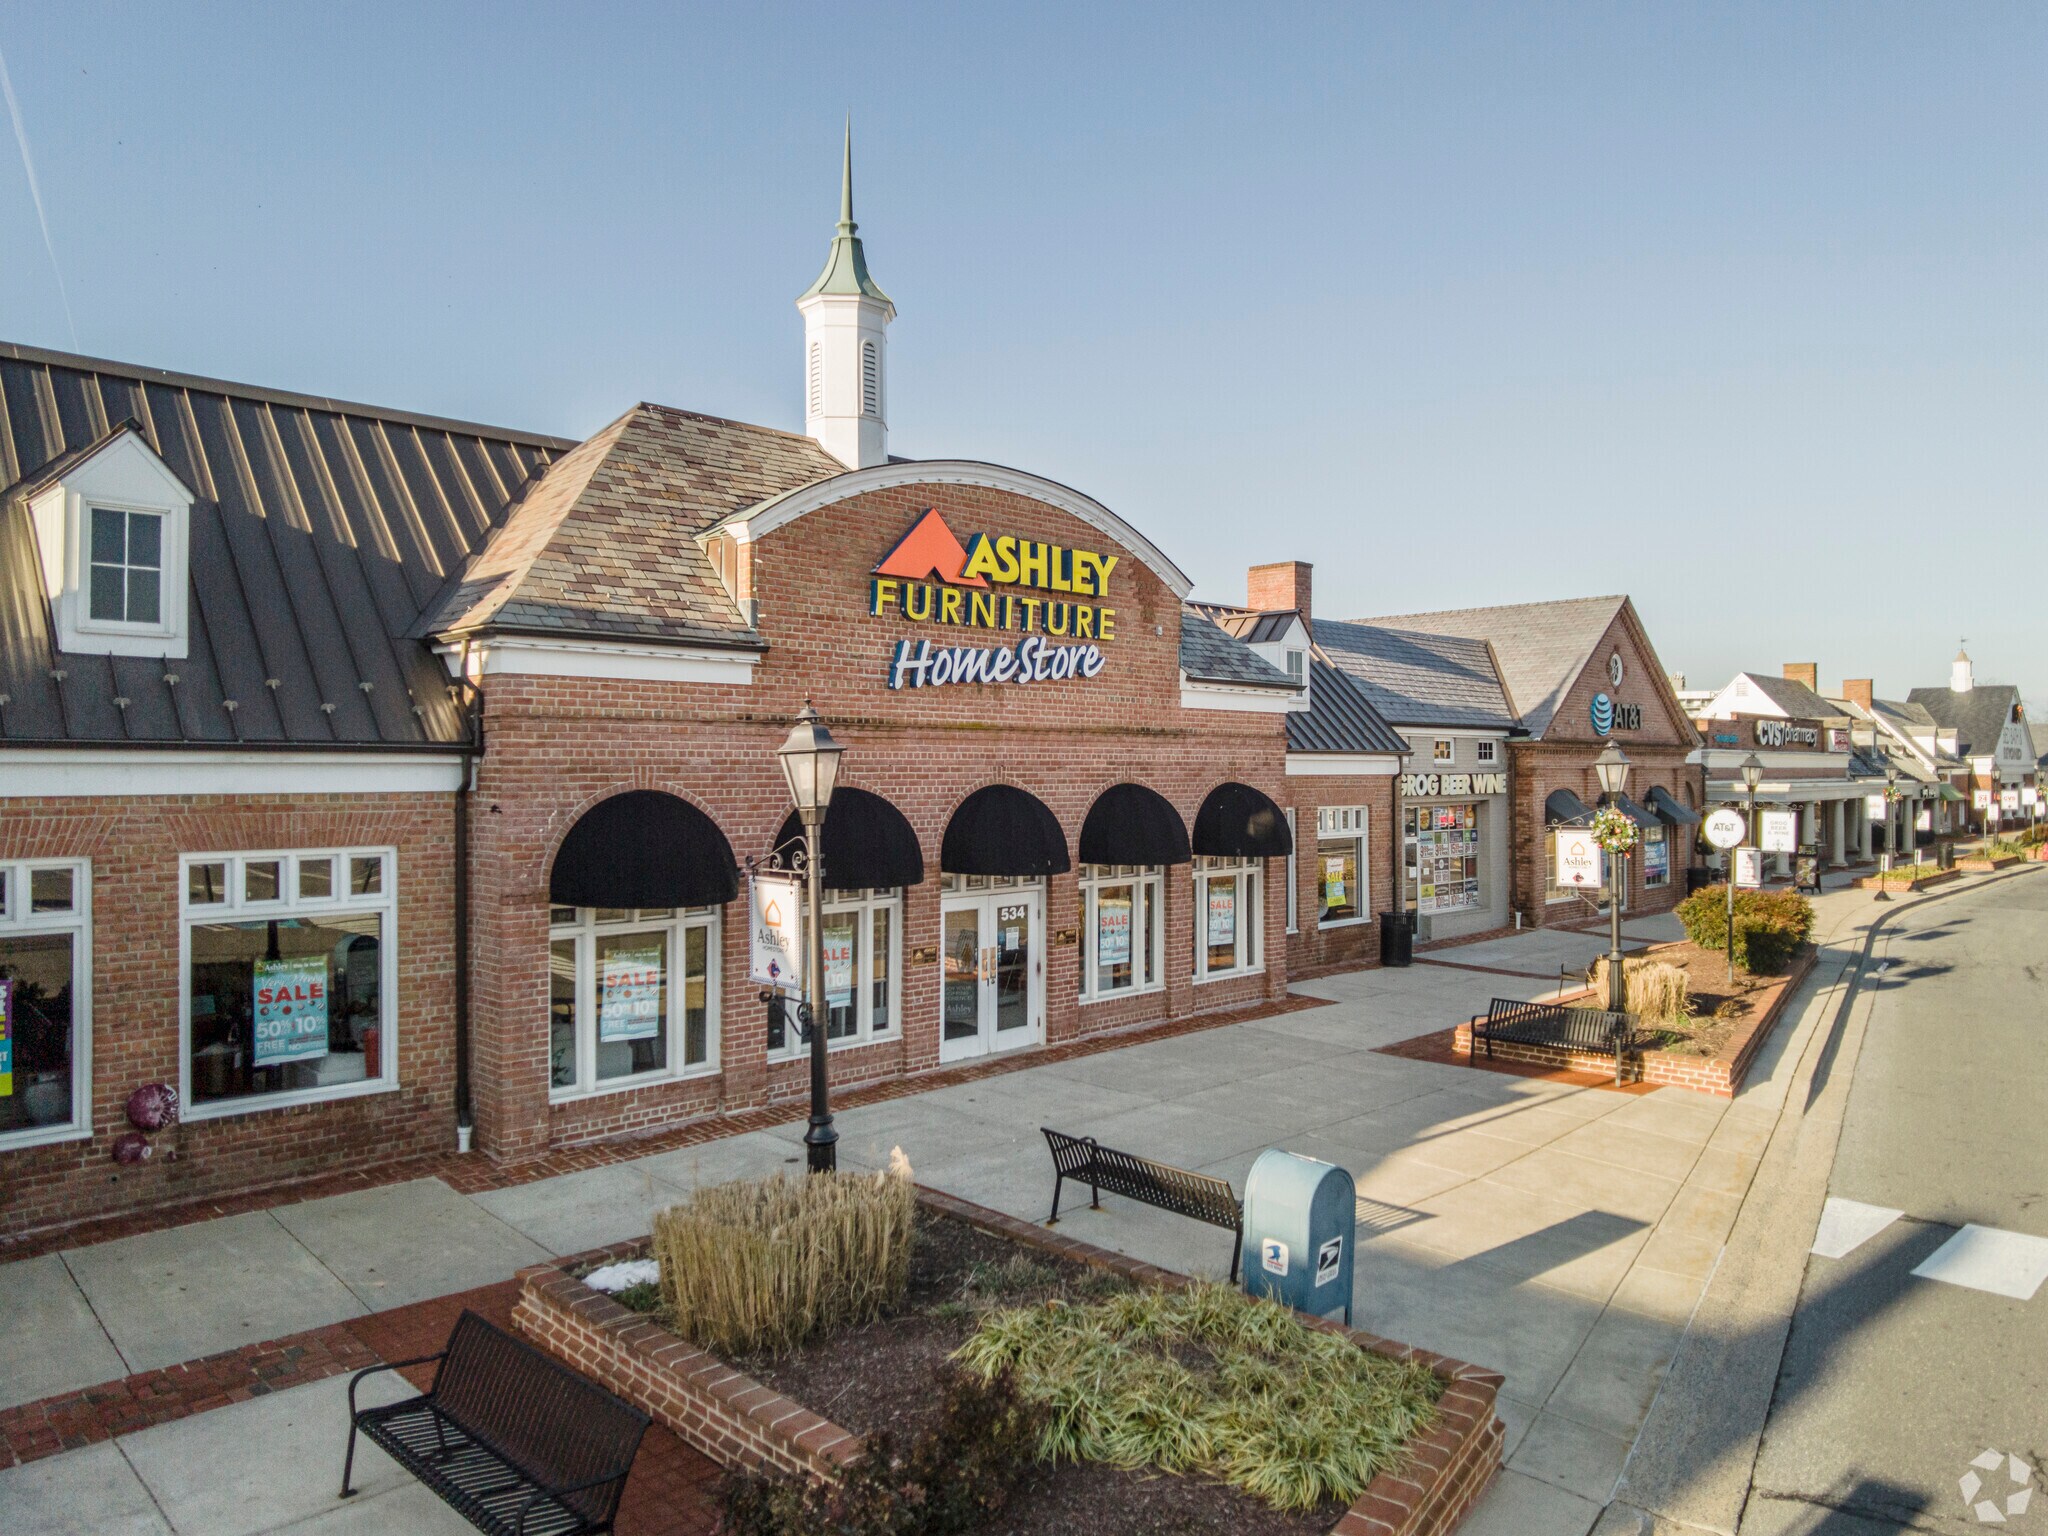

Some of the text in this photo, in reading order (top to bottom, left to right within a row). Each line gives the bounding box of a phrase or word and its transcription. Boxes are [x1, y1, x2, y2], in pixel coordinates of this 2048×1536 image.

[959, 532, 1119, 597] ASHLEY
[870, 579, 1116, 641] FURNITURE
[1613, 703, 1645, 730] AT&T
[1441, 774, 1471, 795] BEER
[1472, 773, 1507, 794] WINE
[1713, 823, 1736, 832] AT&T
[1563, 857, 1592, 866] Ashley
[1210, 899, 1233, 910] SALE
[1001, 906, 1025, 921] 534
[1101, 914, 1128, 927] SALE
[757, 928, 790, 953] Ashley
[822, 947, 850, 961] ALE
[606, 970, 658, 988] SALE
[258, 982, 324, 1005] SALE
[257, 1039, 286, 1051] FREE
